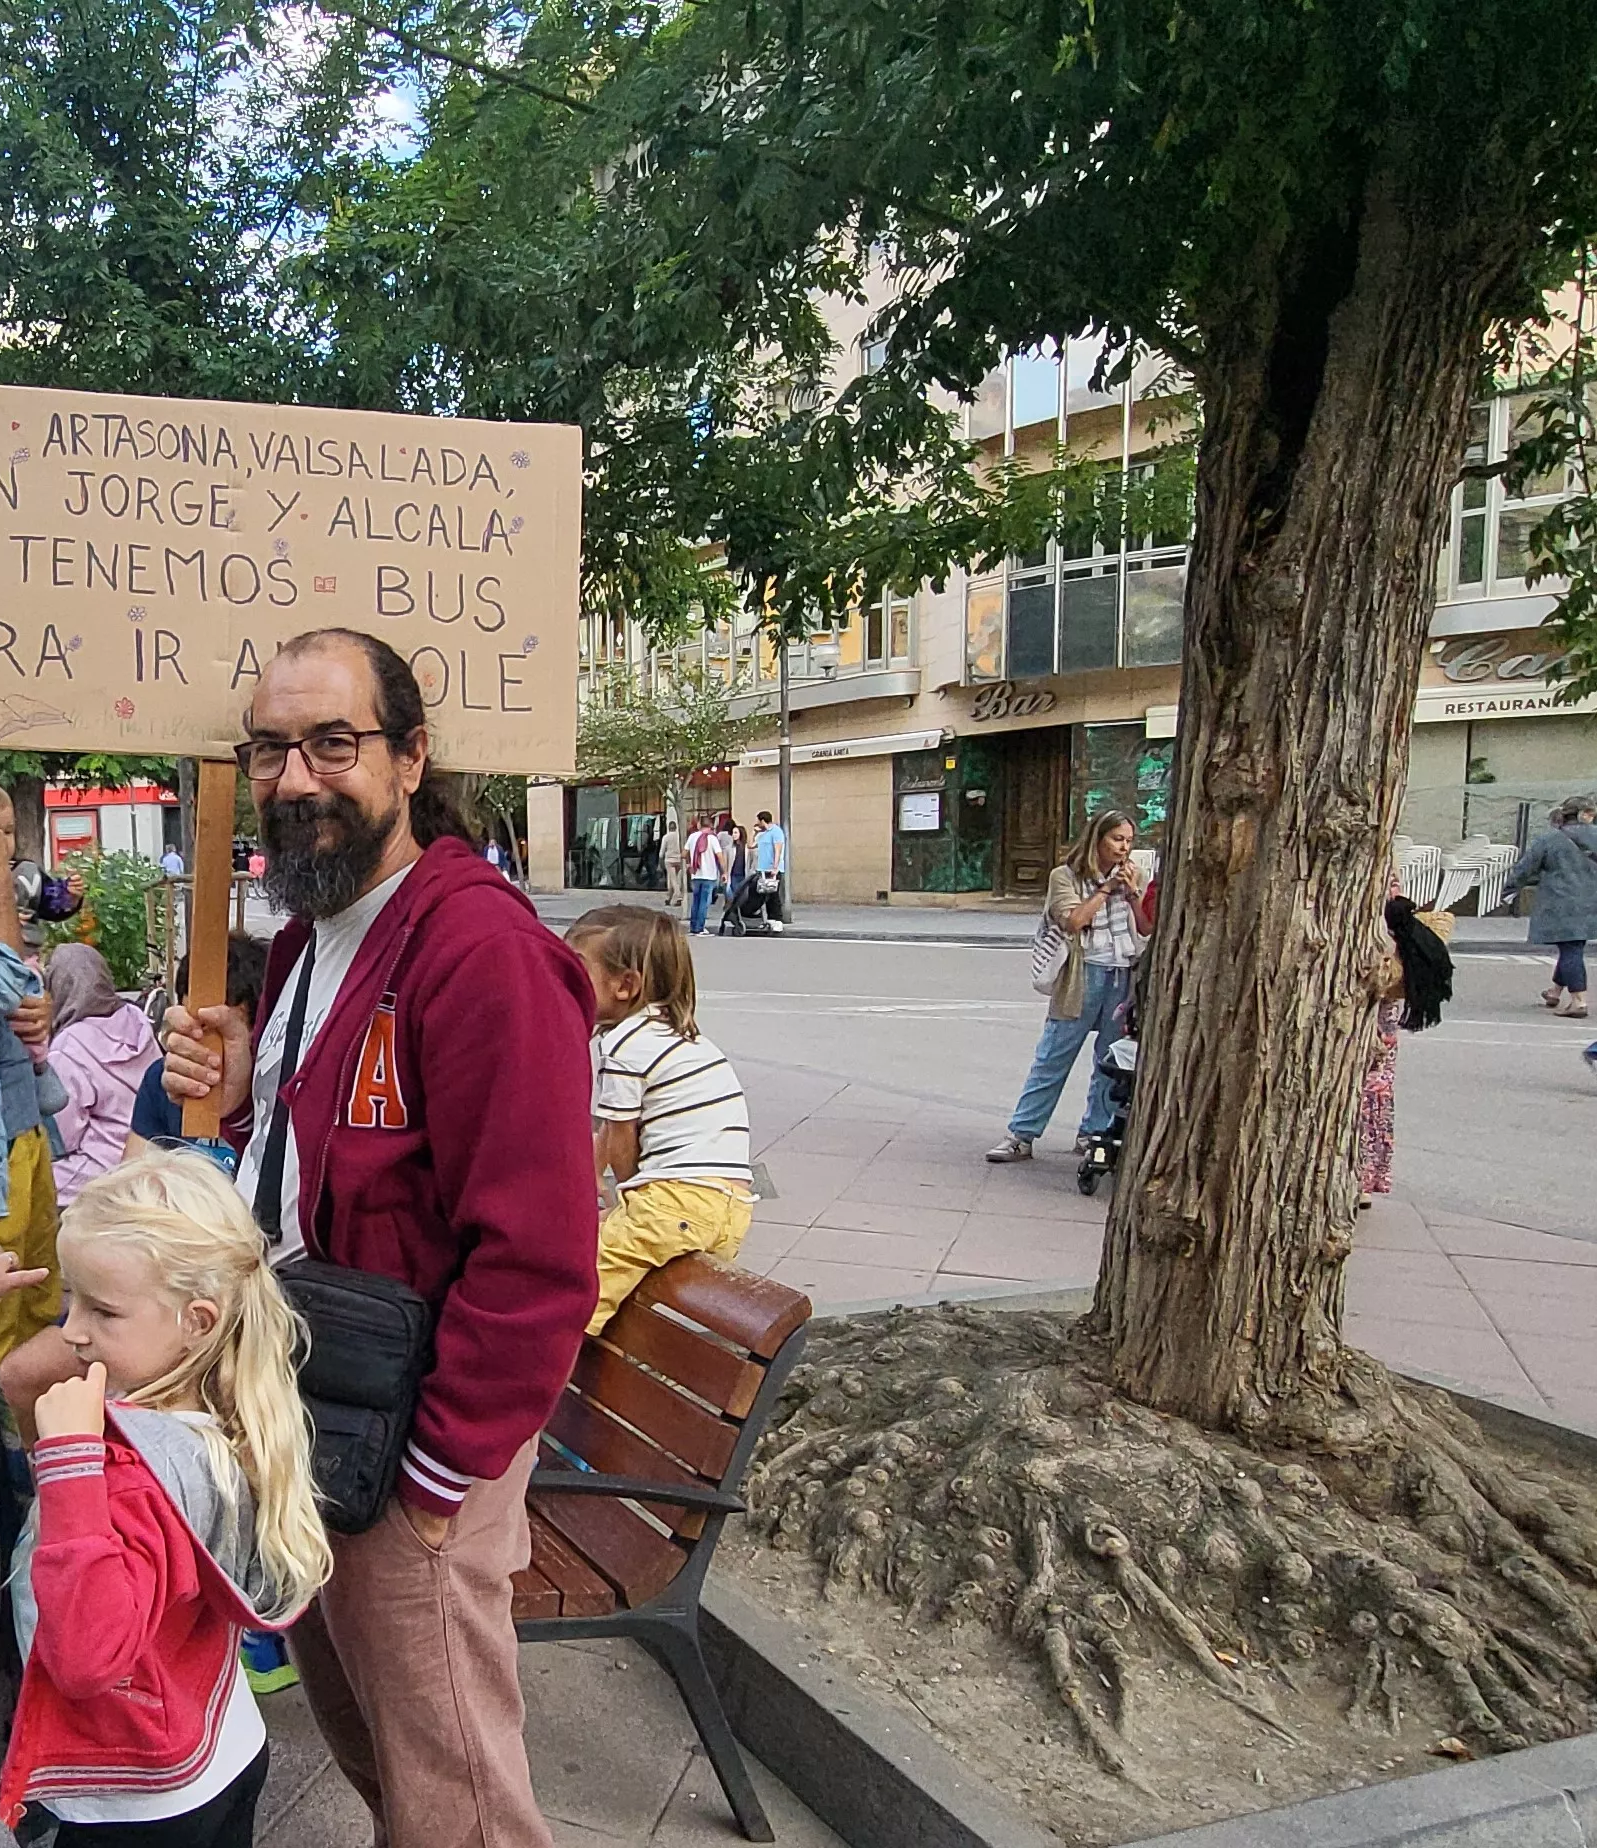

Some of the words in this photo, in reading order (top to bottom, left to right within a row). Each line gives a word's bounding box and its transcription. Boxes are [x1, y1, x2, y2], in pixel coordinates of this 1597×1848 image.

[64, 471, 231, 529] JORGE
[266, 489, 301, 532] Y
[9, 535, 299, 607] TENEMOS
[376, 565, 506, 633] BUS
[135, 628, 189, 685] IR
[230, 638, 283, 690] A
[970, 681, 1057, 721] Bar
[1445, 698, 1572, 715] RESTAURANE
